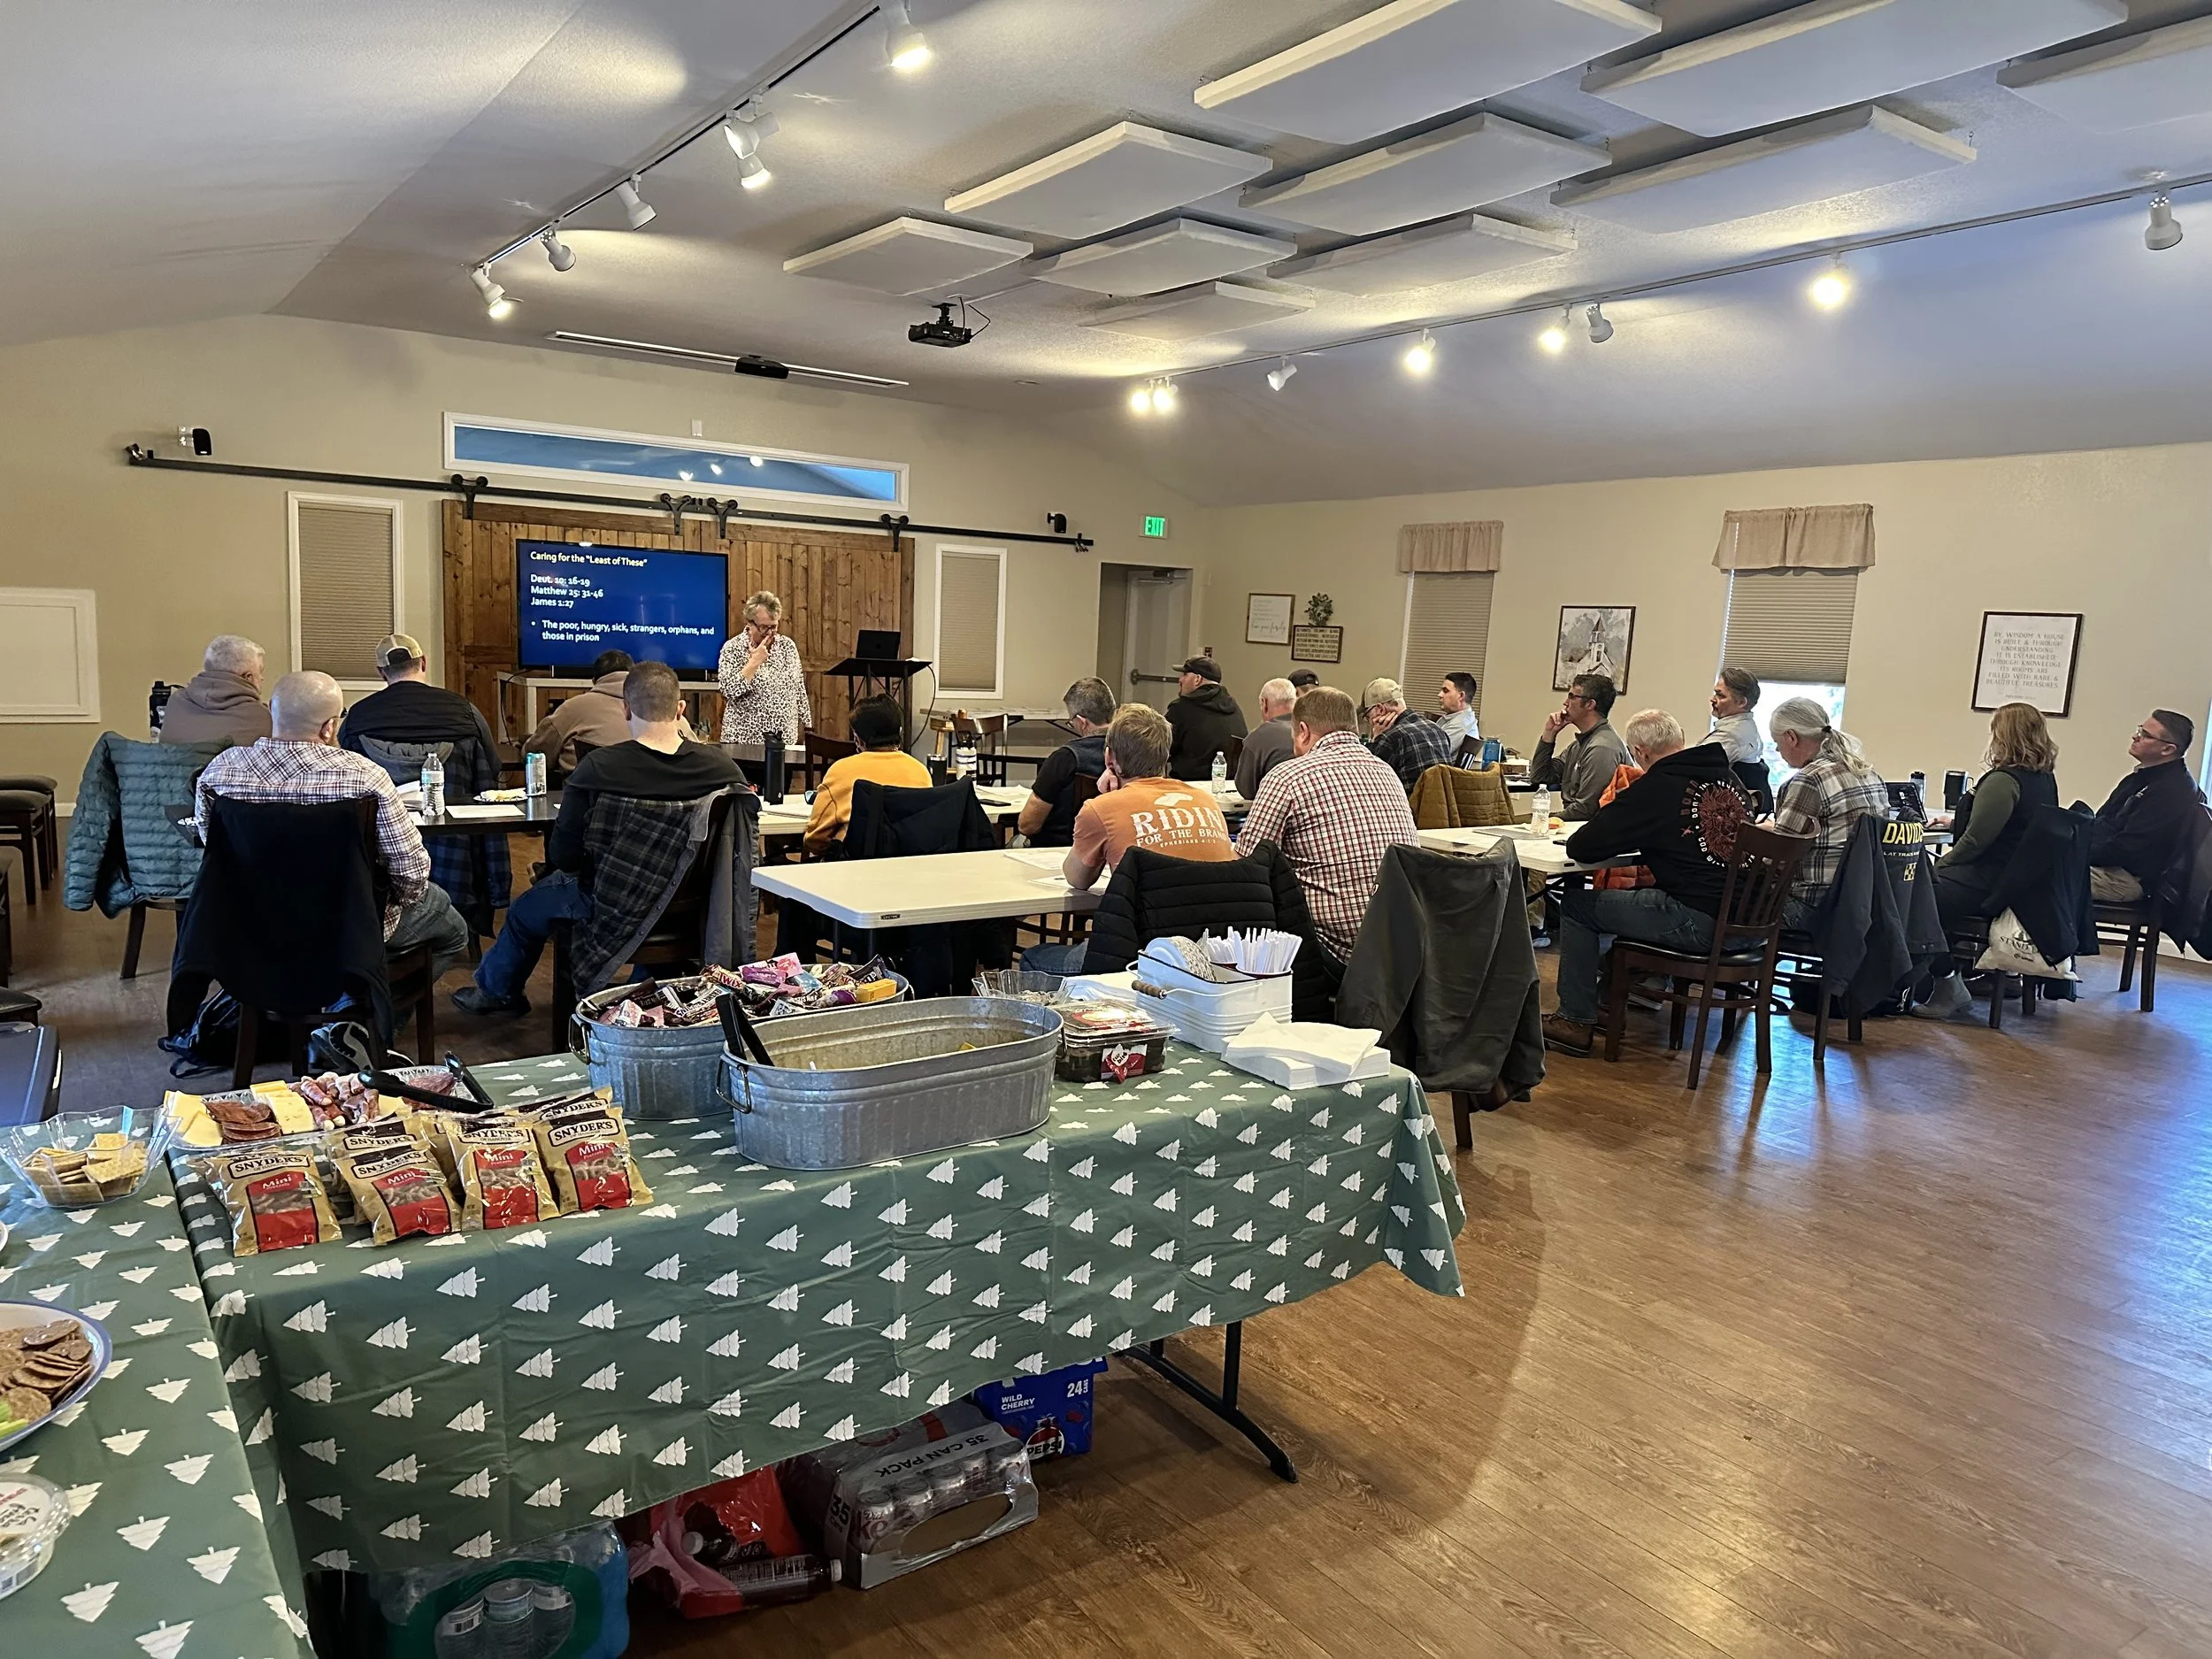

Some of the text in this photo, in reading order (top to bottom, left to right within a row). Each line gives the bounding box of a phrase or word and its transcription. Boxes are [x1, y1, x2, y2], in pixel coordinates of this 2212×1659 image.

[1145, 516, 1165, 537] EXIT
[530, 551, 648, 567] Caring for the “Least of These”
[530, 574, 554, 584] Deut.
[567, 576, 590, 587] 16-19
[531, 586, 603, 599] Matthew 25: 31-46
[530, 596, 574, 609] James 1:27
[541, 619, 715, 636] The poor, hungry, sick, strangers, orphans, and
[541, 631, 600, 643] those in prison
[1691, 792, 1701, 818] DON'T
[1130, 806, 1225, 838] RIDIN
[1136, 828, 1227, 848] FOR THE BRAND
[1999, 935, 2029, 950] STAND
[717, 972, 742, 988] TWIX
[554, 1121, 613, 1141] SNYDER'S
[234, 1156, 303, 1172] SNYDER'S
[262, 1174, 292, 1189] Mini
[1066, 1380, 1083, 1398] 24
[1001, 1394, 1023, 1403] WILD
[1001, 1398, 1035, 1410] CHERRY
[1026, 1437, 1063, 1455] PEPSI
[874, 1434, 990, 1479] 35 CAN PACK
